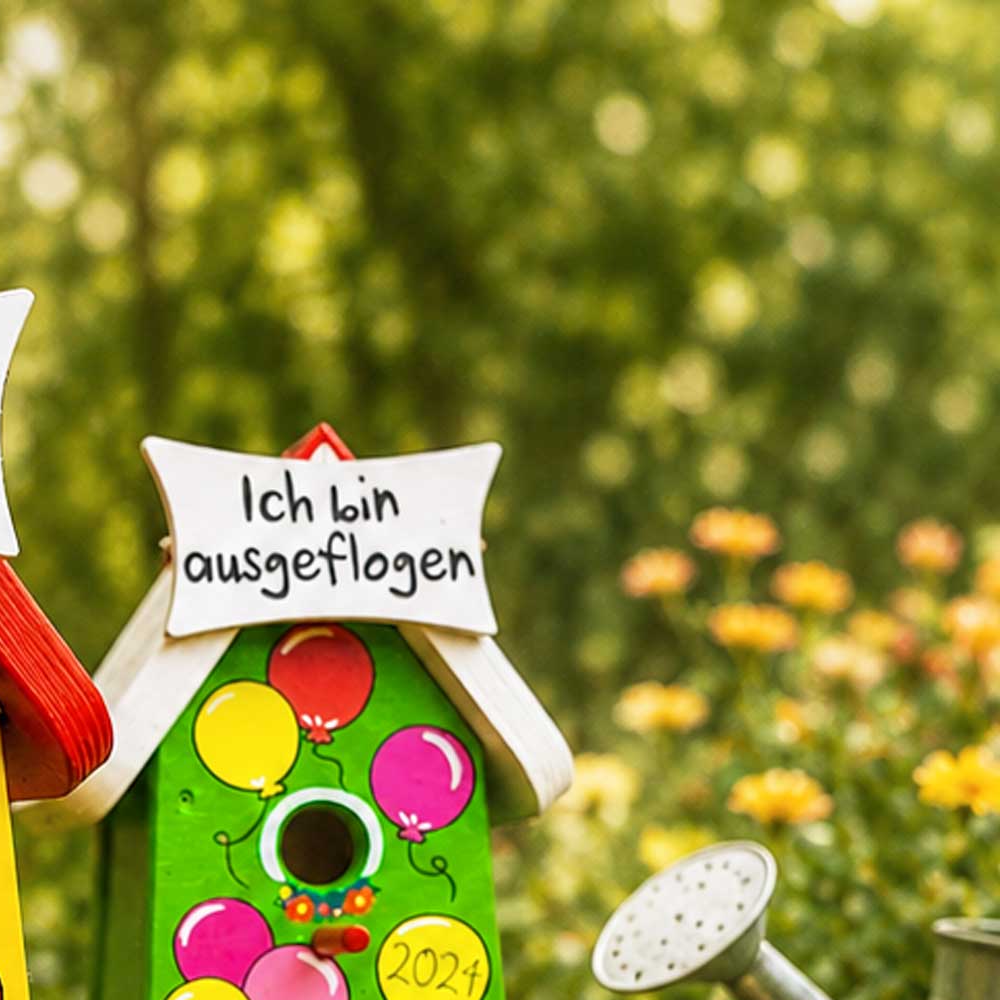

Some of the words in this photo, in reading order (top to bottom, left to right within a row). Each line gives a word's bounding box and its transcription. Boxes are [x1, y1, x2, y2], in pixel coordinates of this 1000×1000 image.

[242, 469, 314, 523] Ich
[330, 475, 400, 523] bin
[183, 530, 476, 600] ausgeflogen
[387, 941, 482, 998] 2024
